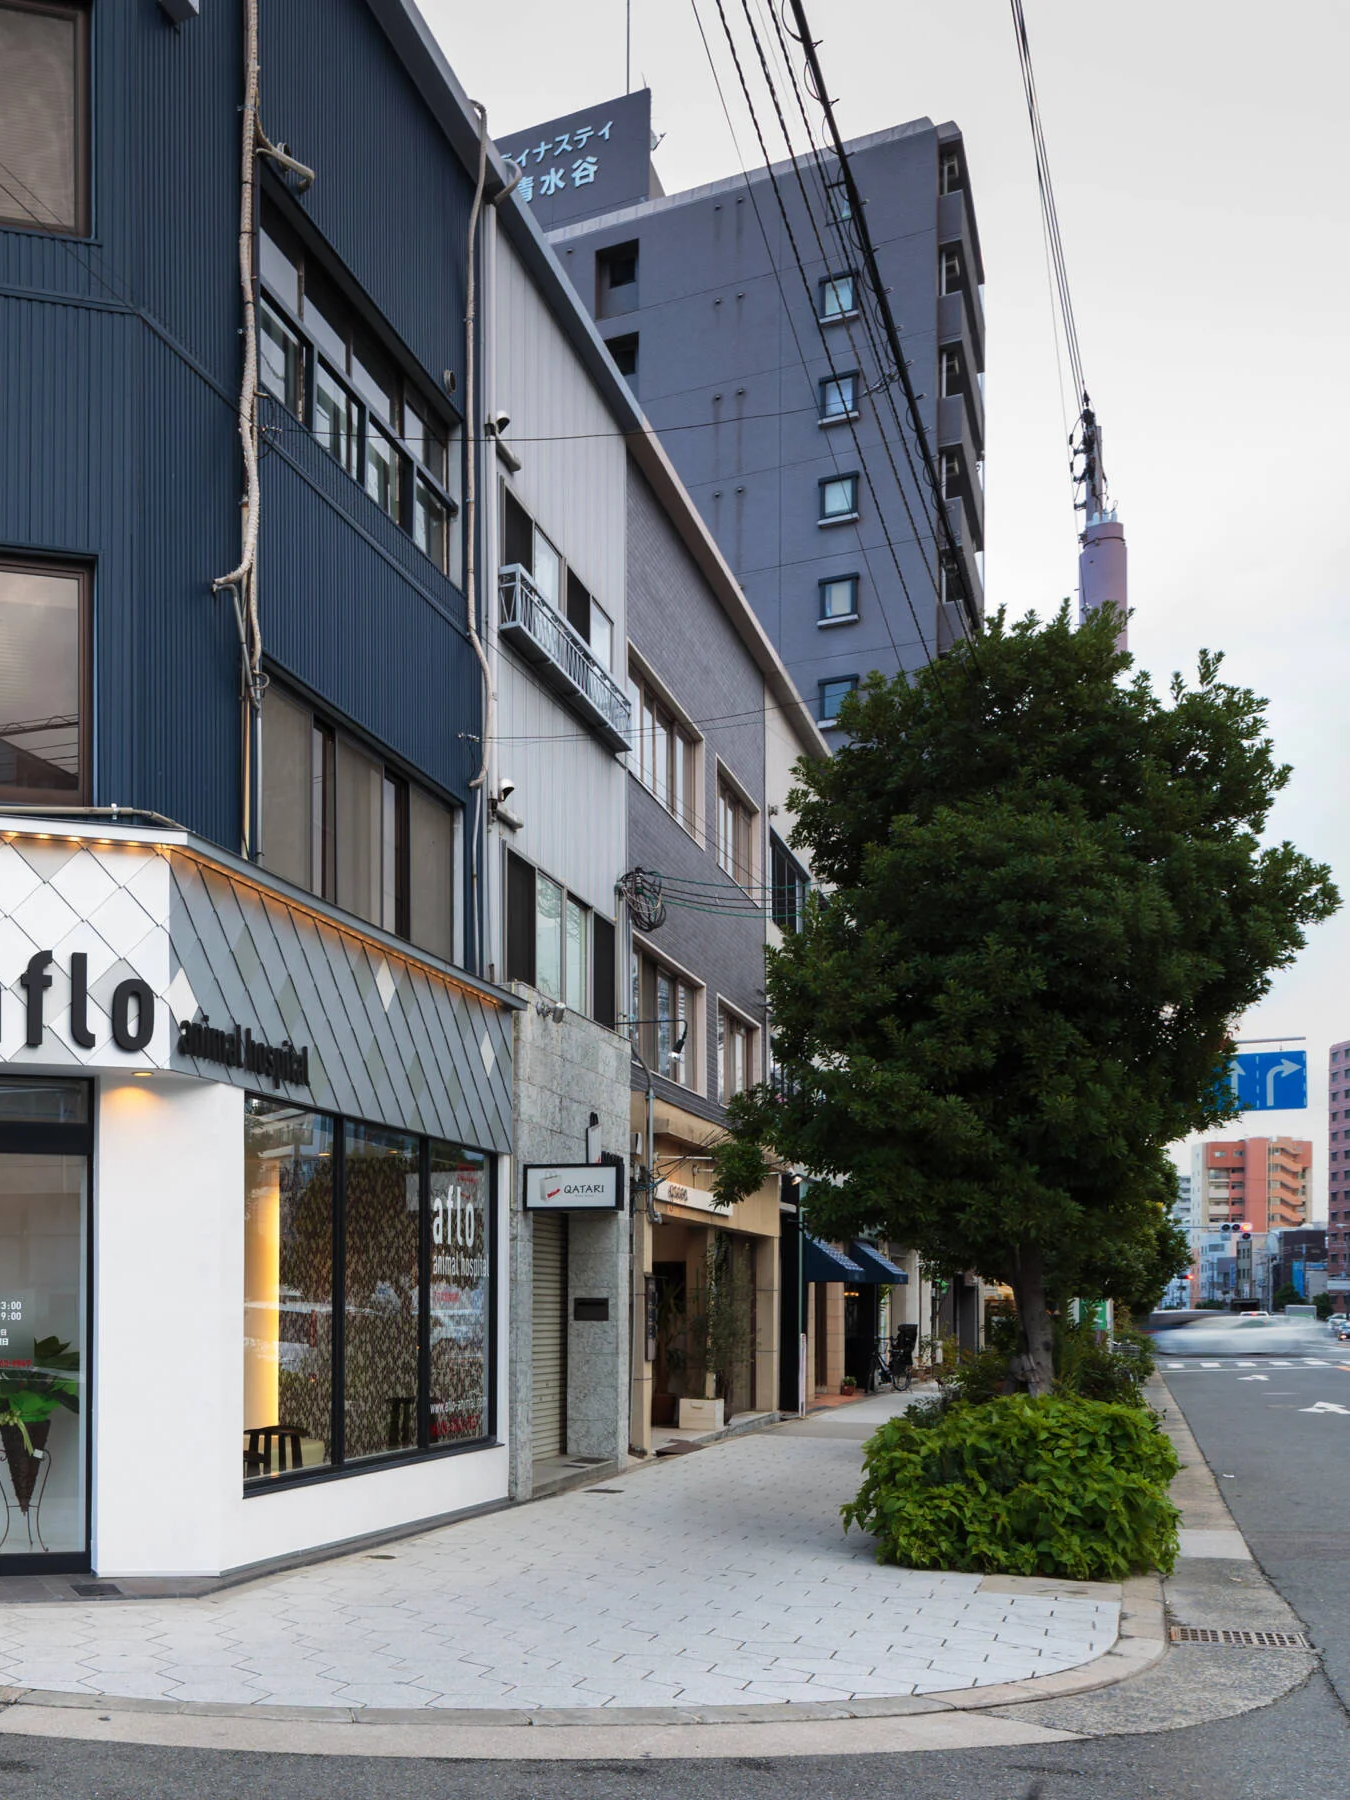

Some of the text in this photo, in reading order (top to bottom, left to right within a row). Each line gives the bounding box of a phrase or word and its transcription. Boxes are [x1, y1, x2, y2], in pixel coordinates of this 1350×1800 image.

[177, 1014, 310, 1090] animal hospital
[563, 1184, 604, 1194] QATARI
[433, 1184, 475, 1248] aflo
[433, 1248, 489, 1281] animal hospital
